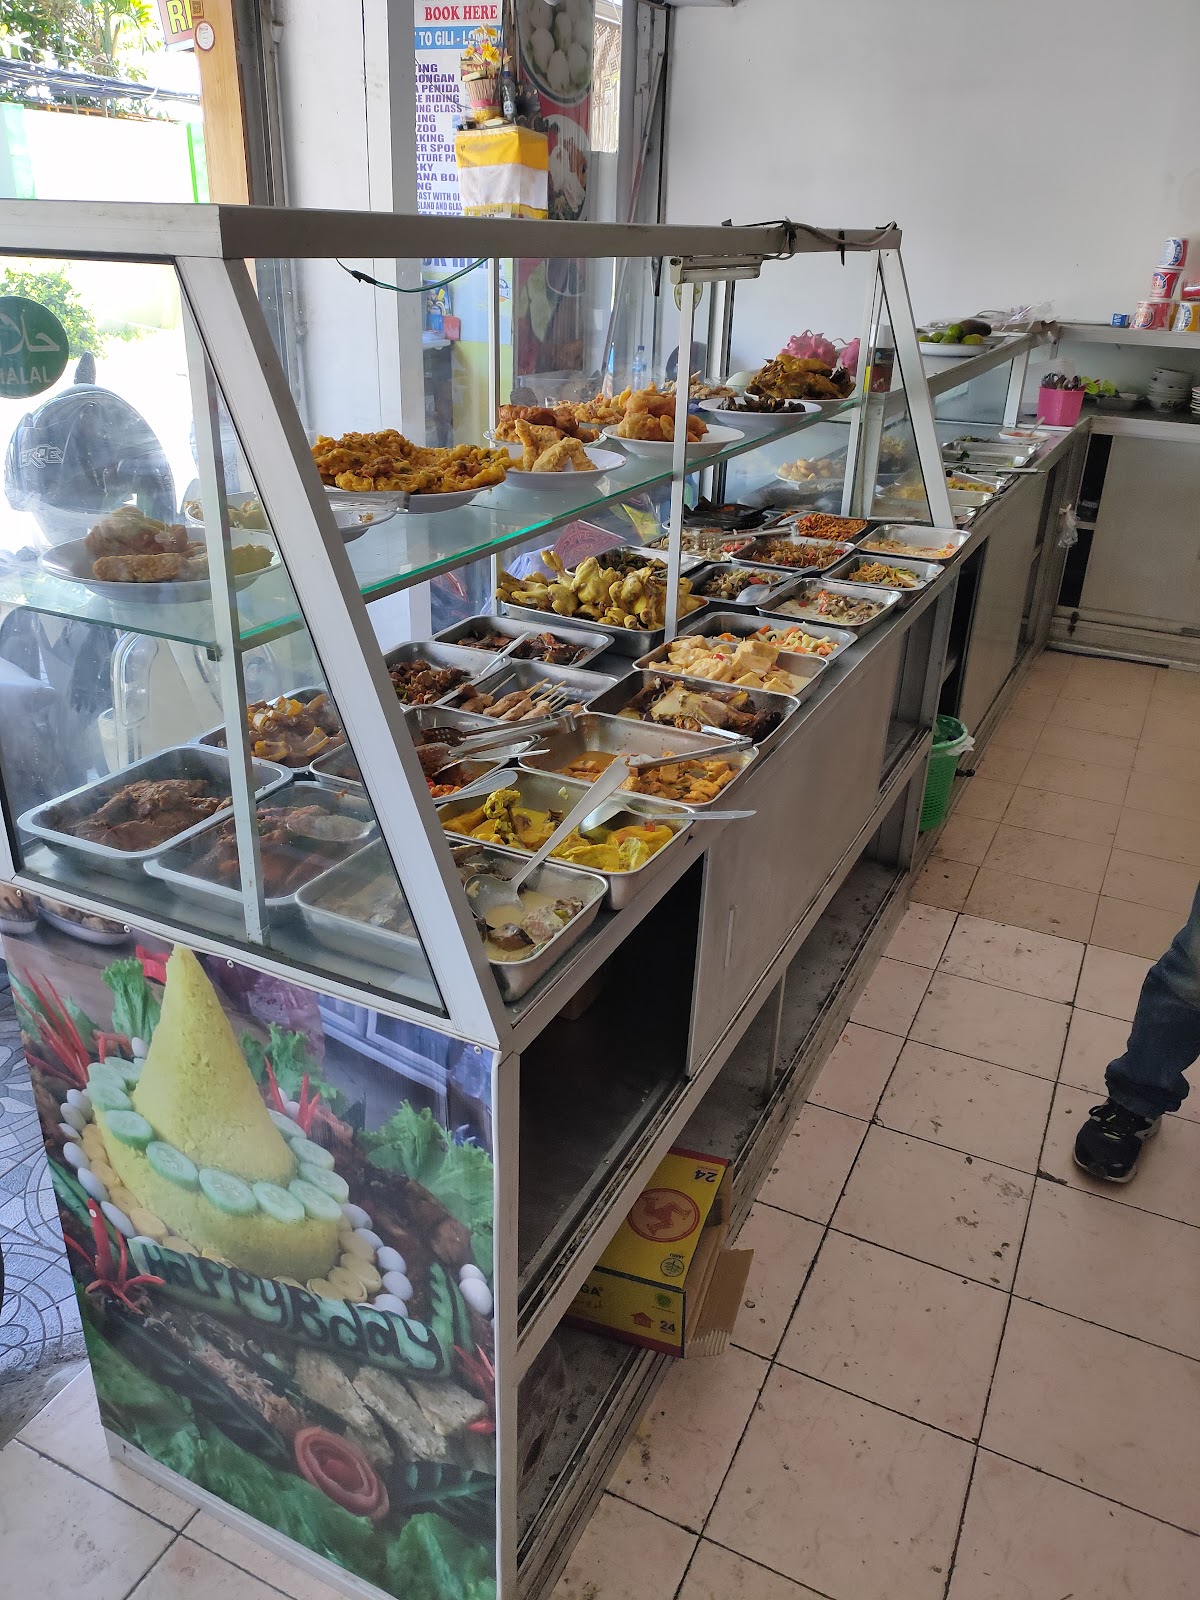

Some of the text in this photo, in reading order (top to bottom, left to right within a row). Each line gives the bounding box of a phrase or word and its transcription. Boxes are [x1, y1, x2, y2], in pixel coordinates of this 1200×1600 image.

[424, 5, 498, 20] BOOK HERE
[419, 31, 432, 45] TO
[435, 30, 454, 45] GILI
[415, 63, 438, 72] ING
[422, 84, 460, 93] PENIDA
[425, 94, 460, 103] RIDING
[434, 104, 463, 113] CLASS
[417, 124, 437, 132] ZOO
[440, 173, 459, 182] BO
[433, 192, 452, 201] WITH
[436, 202, 448, 210] AND
[659, 1320, 676, 1333] 24
